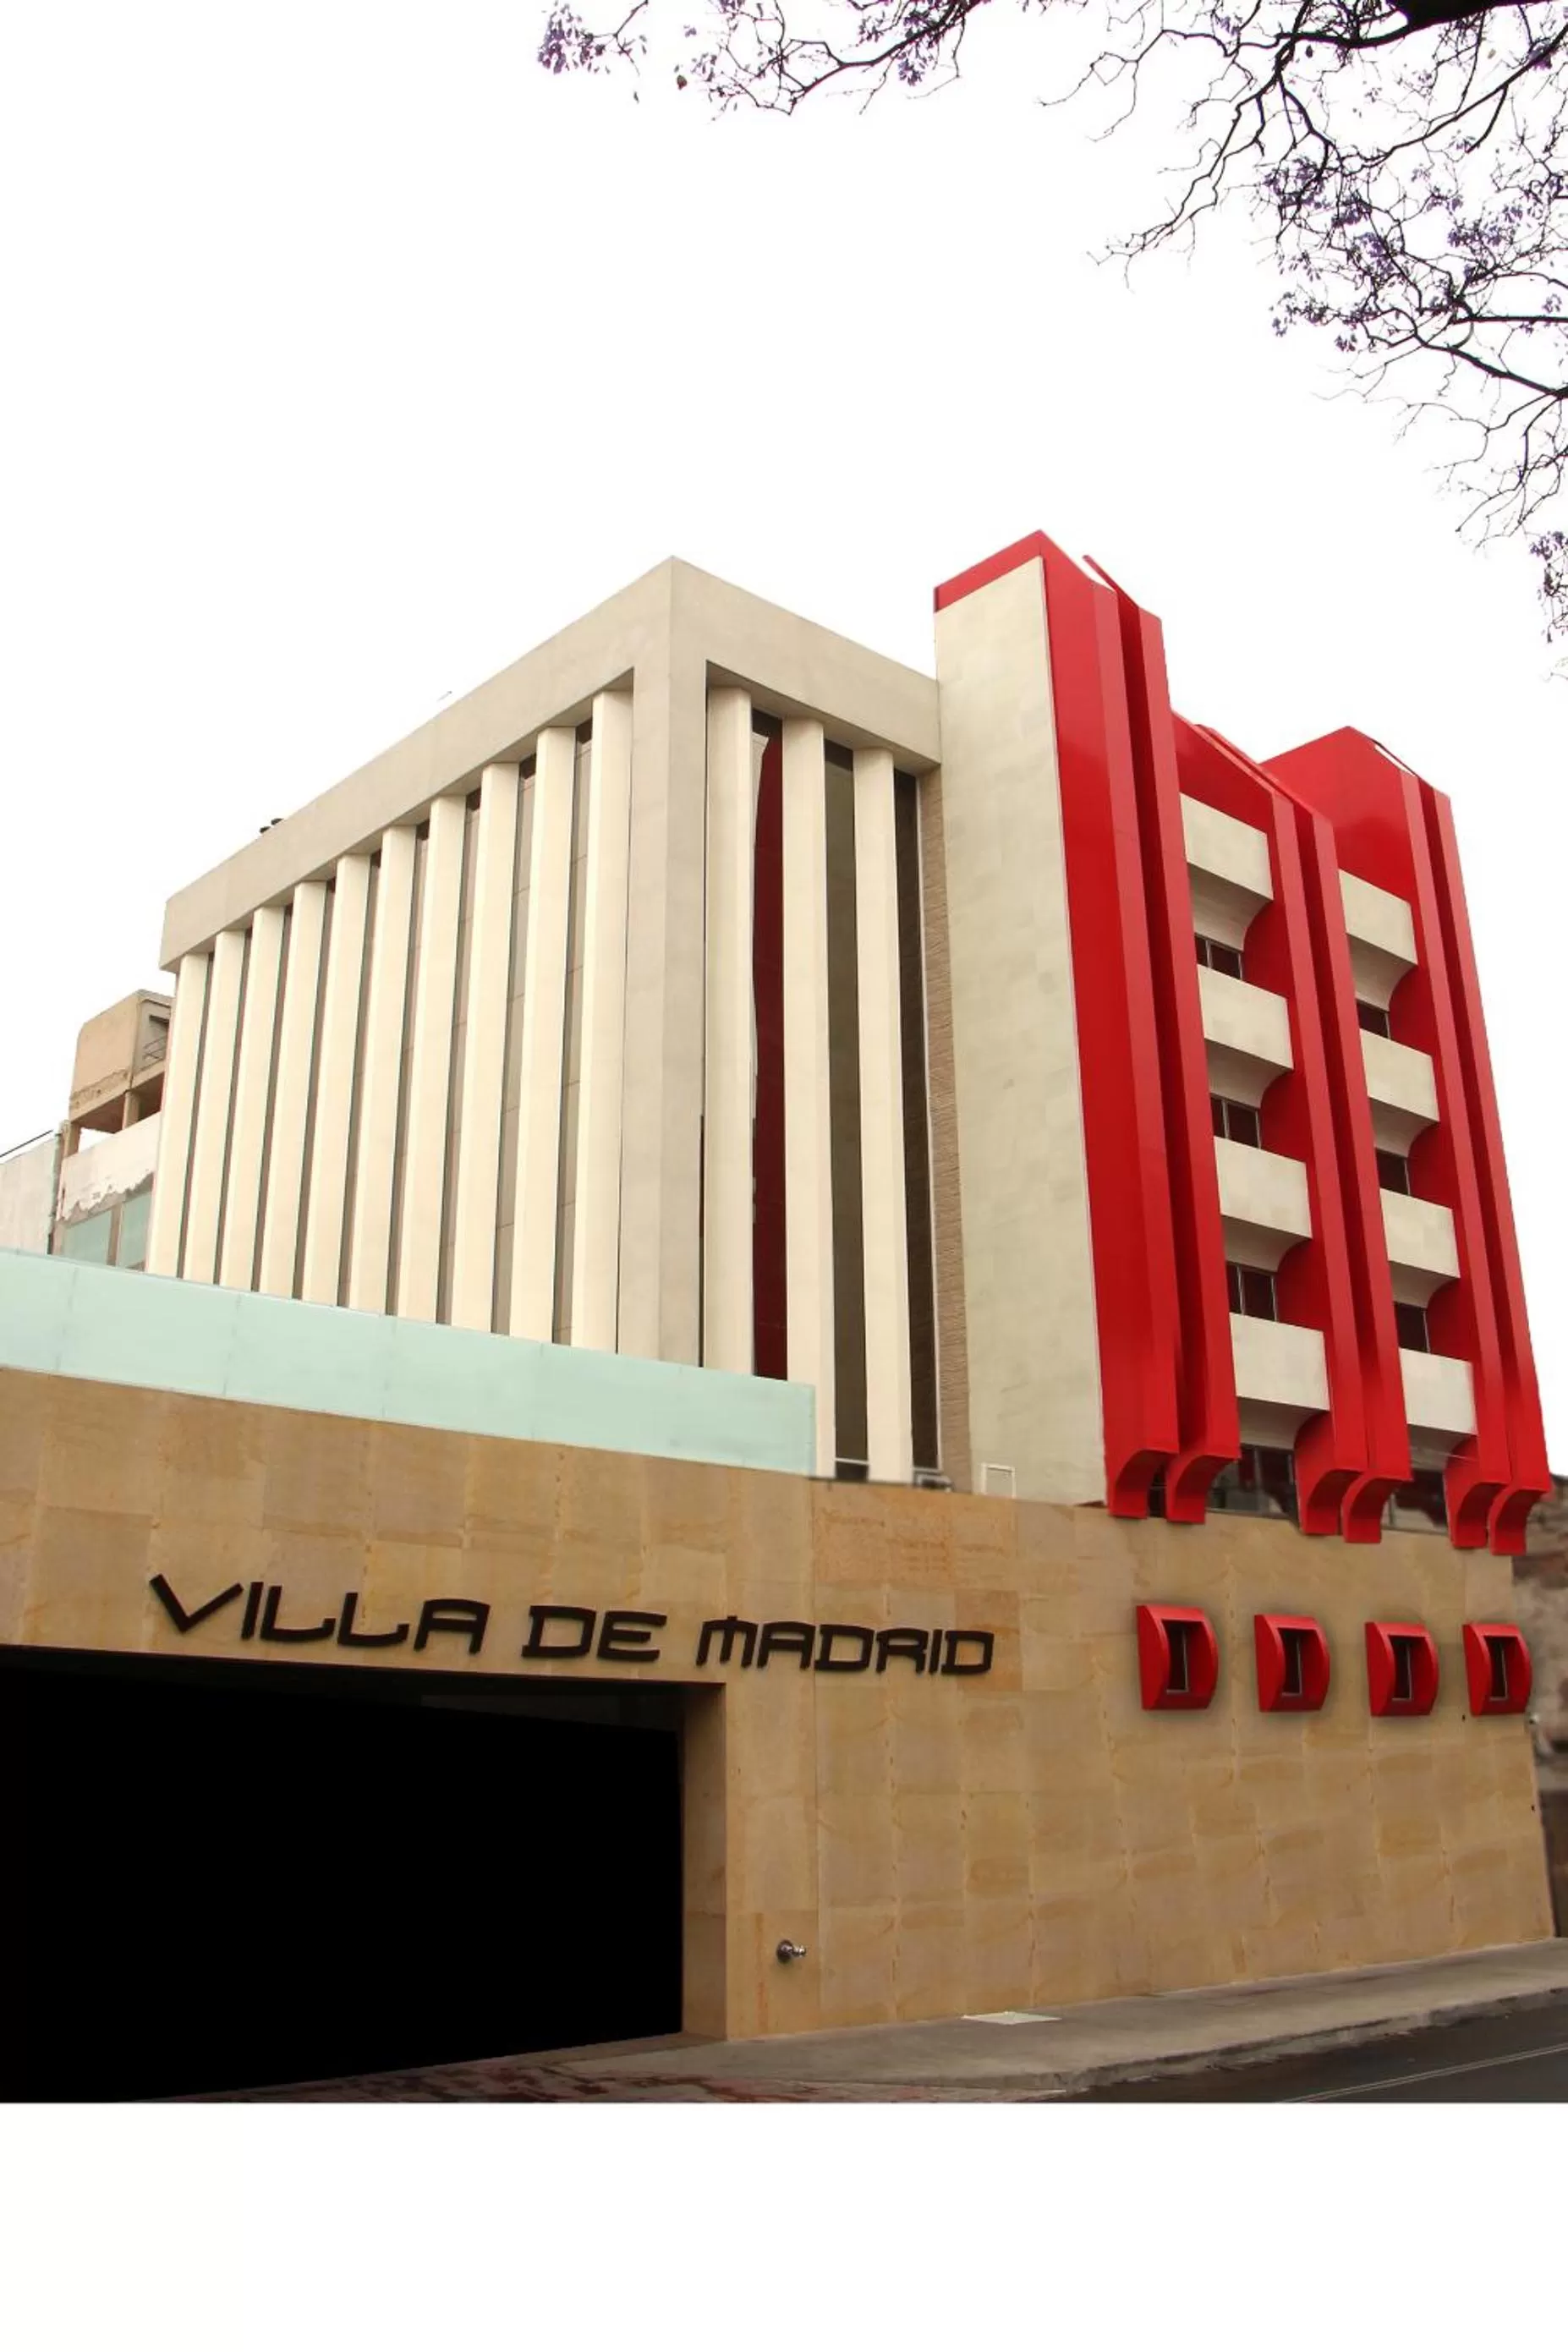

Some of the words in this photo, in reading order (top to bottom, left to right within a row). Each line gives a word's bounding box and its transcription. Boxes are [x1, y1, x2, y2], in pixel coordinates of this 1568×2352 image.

[149, 1573, 491, 1656] VILLA
[520, 1604, 667, 1664] DE
[694, 1615, 995, 1678] MADRID
